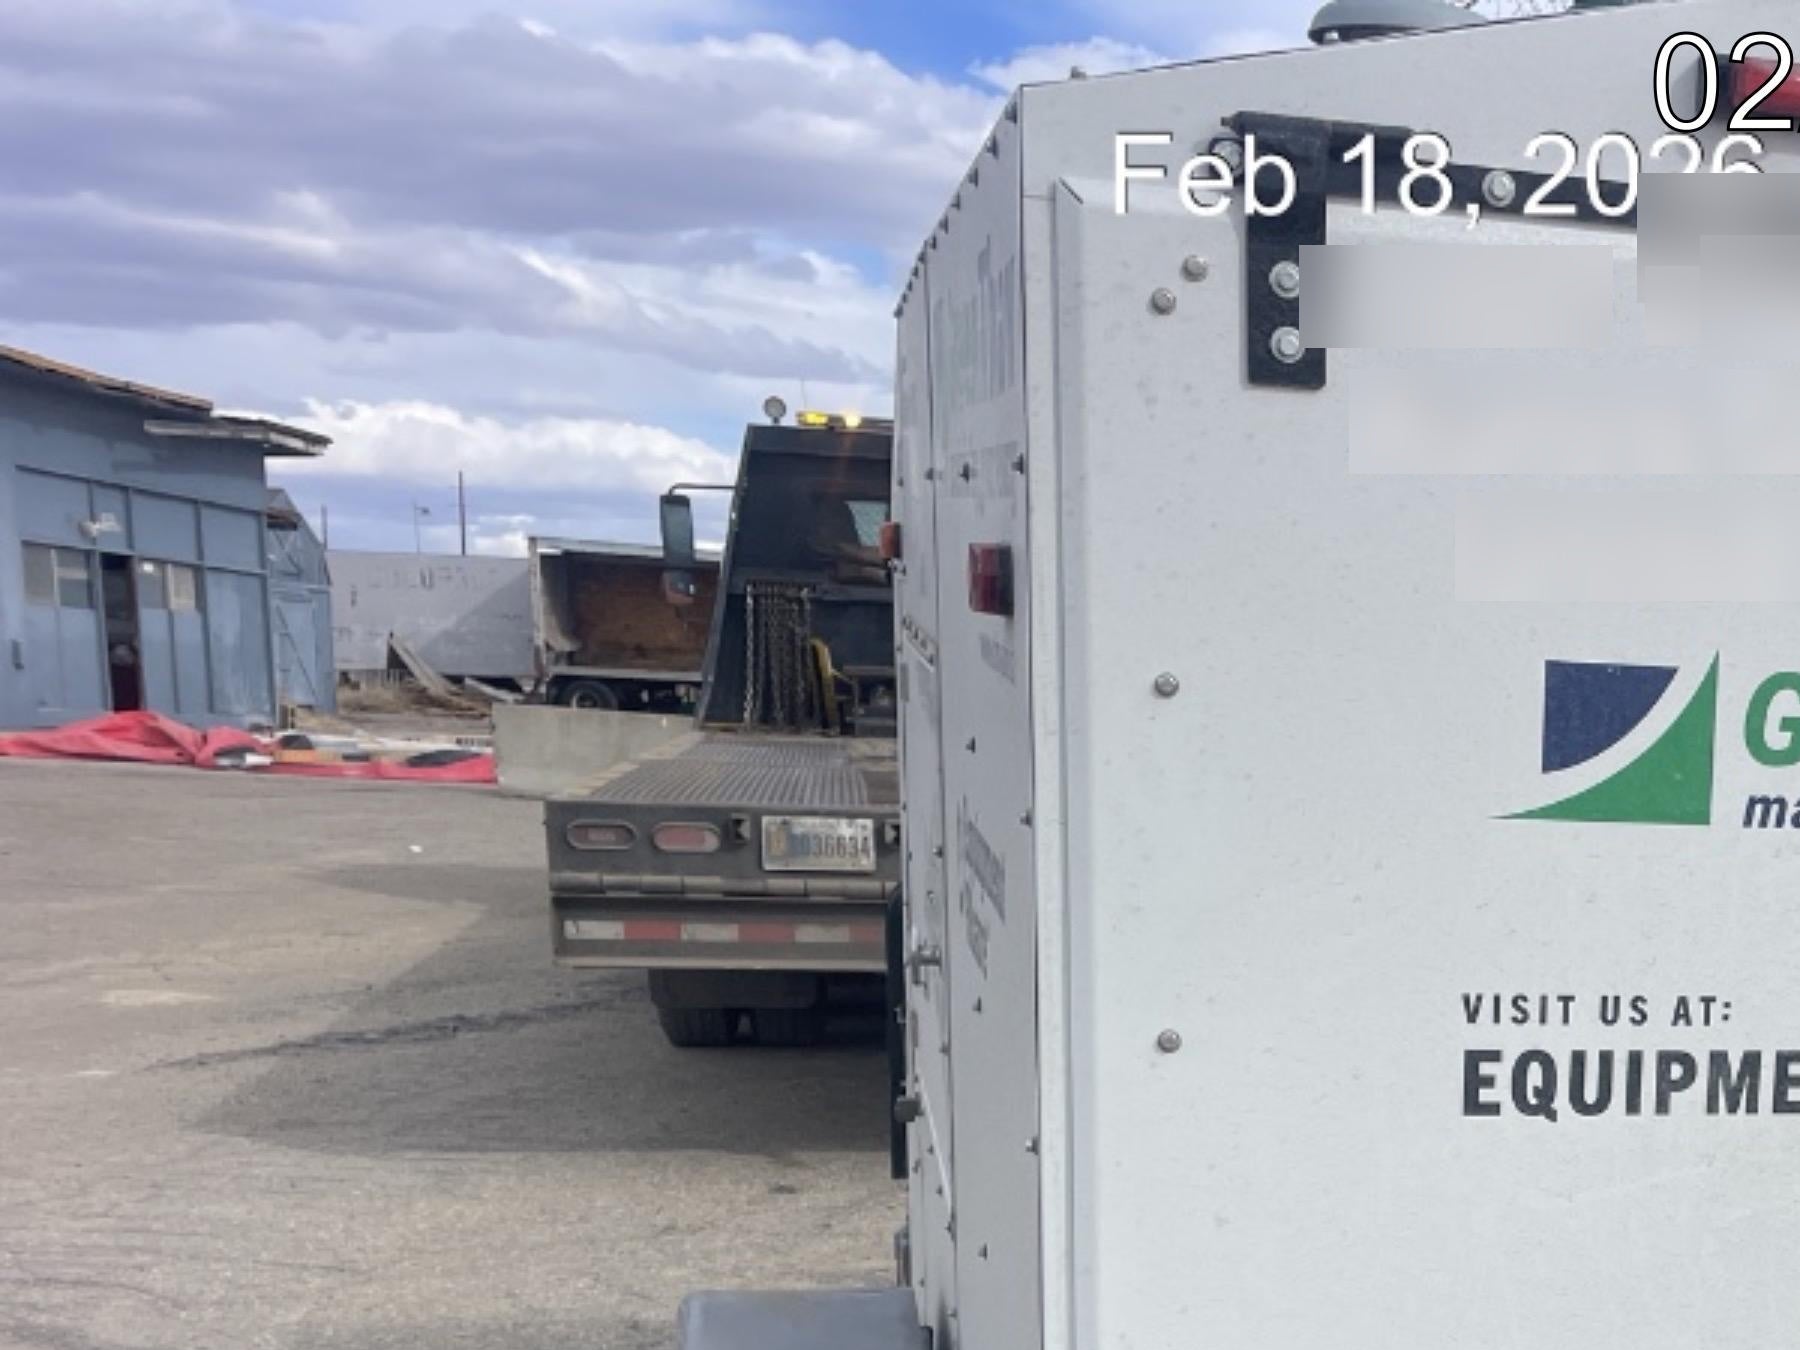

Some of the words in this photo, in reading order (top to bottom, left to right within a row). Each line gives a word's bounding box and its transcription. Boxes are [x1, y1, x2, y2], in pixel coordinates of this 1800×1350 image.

[1461, 993, 1577, 1026] VISIT
[1599, 993, 1650, 1026] US
[1671, 994, 1733, 1028] AT:
